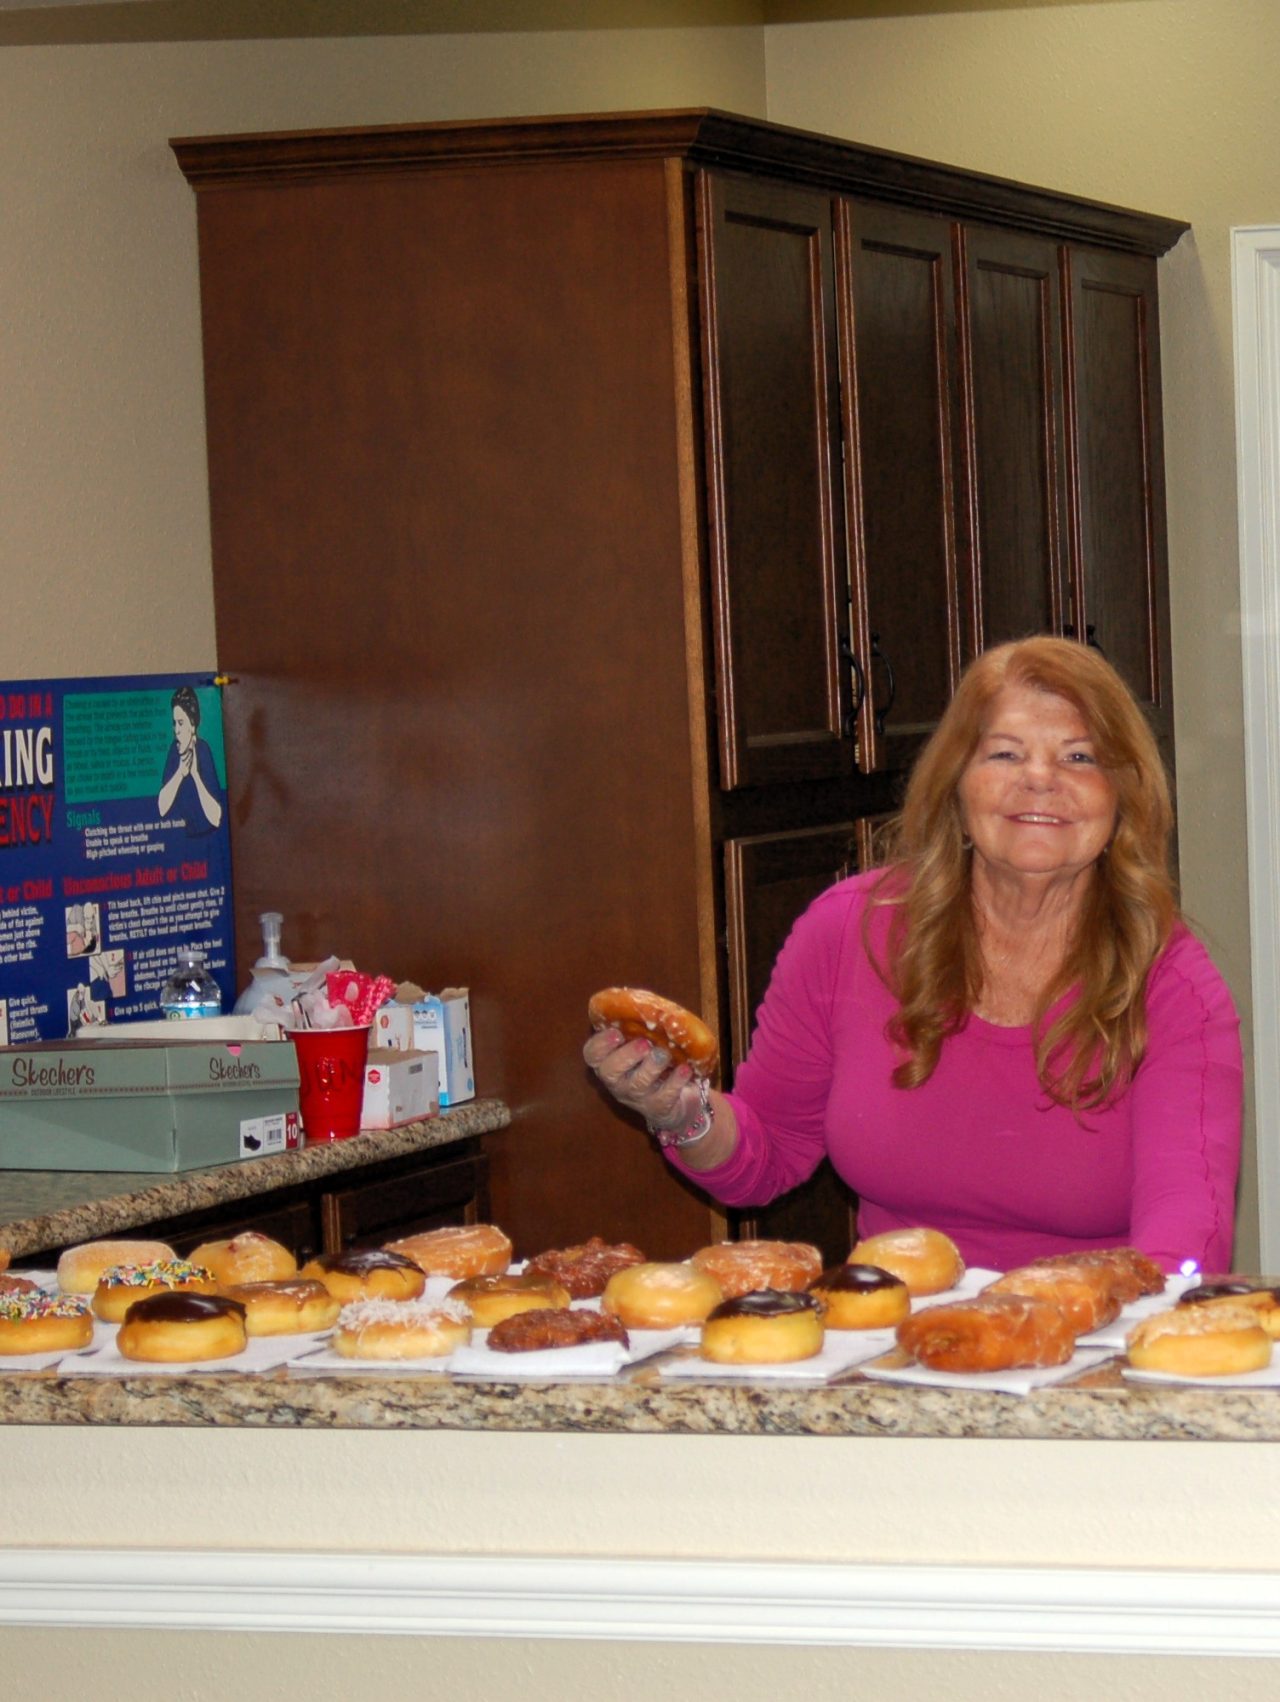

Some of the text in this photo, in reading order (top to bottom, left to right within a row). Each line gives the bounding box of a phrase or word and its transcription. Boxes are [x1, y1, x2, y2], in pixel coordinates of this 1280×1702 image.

[0, 727, 54, 786] ING
[66, 809, 101, 830] Signals
[136, 867, 164, 886] Adult
[180, 861, 208, 880] Child
[12, 1058, 95, 1087] Skechers
[209, 1057, 261, 1080] Skechers
[287, 1124, 298, 1140] 10
